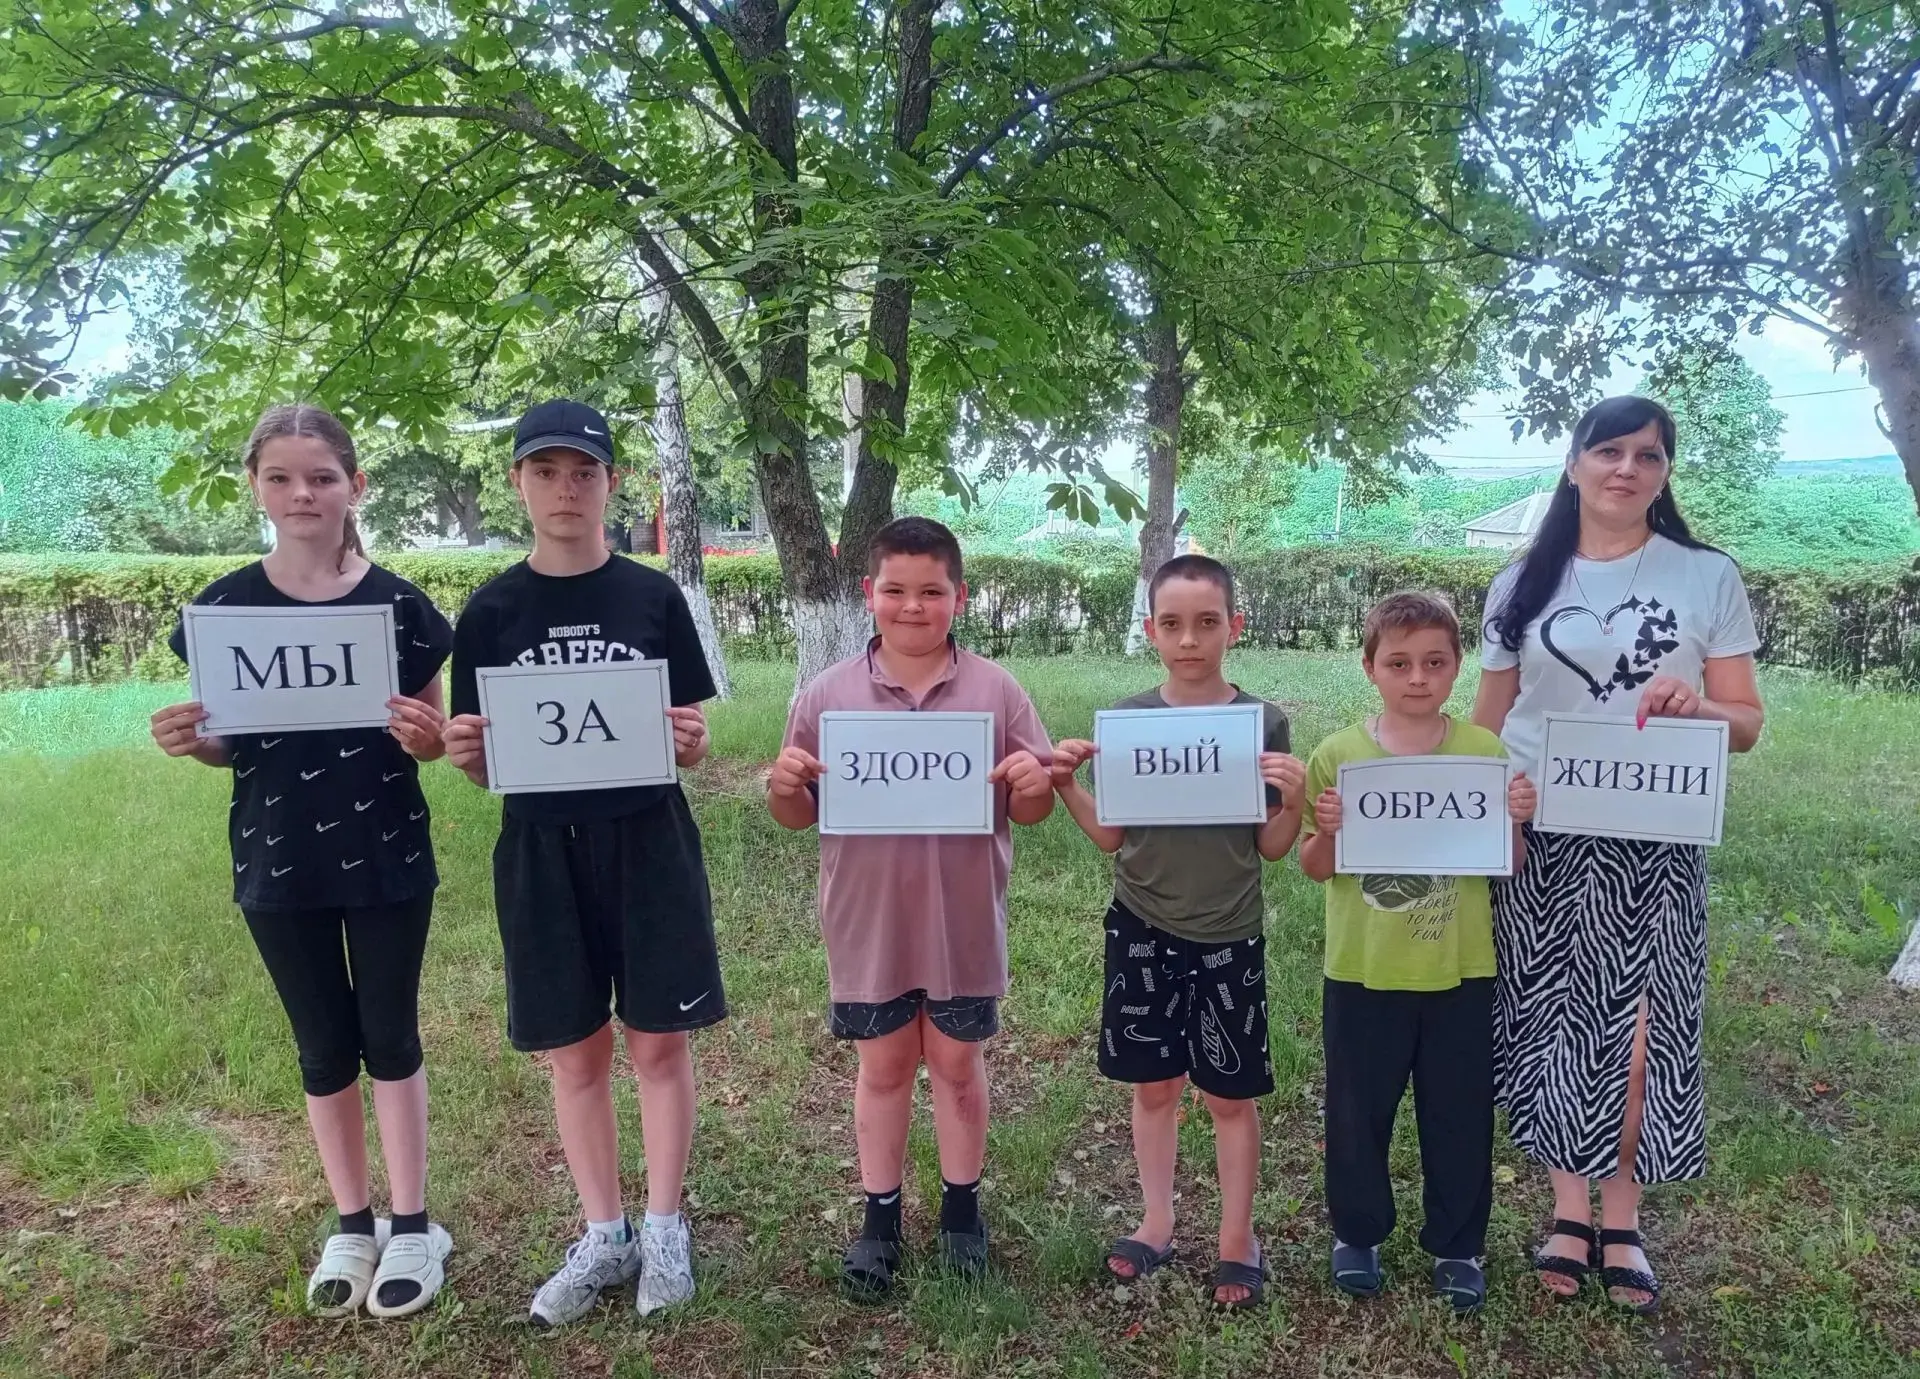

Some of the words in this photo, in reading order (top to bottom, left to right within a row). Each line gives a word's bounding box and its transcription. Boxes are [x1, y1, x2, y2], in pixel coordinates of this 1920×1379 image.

[548, 624, 600, 638] NOBODY'S
[226, 643, 360, 690] МЫ
[510, 640, 645, 667] ERFECT
[536, 699, 620, 745] ЗА
[840, 751, 971, 787] ЗДОРО
[1131, 737, 1223, 775] ВЫЙ
[1551, 757, 1712, 795] ЖИЗНИ
[1358, 791, 1487, 820] ОБРАЗ
[1406, 914, 1425, 926] TO
[1120, 1004, 1151, 1016] NIKE
